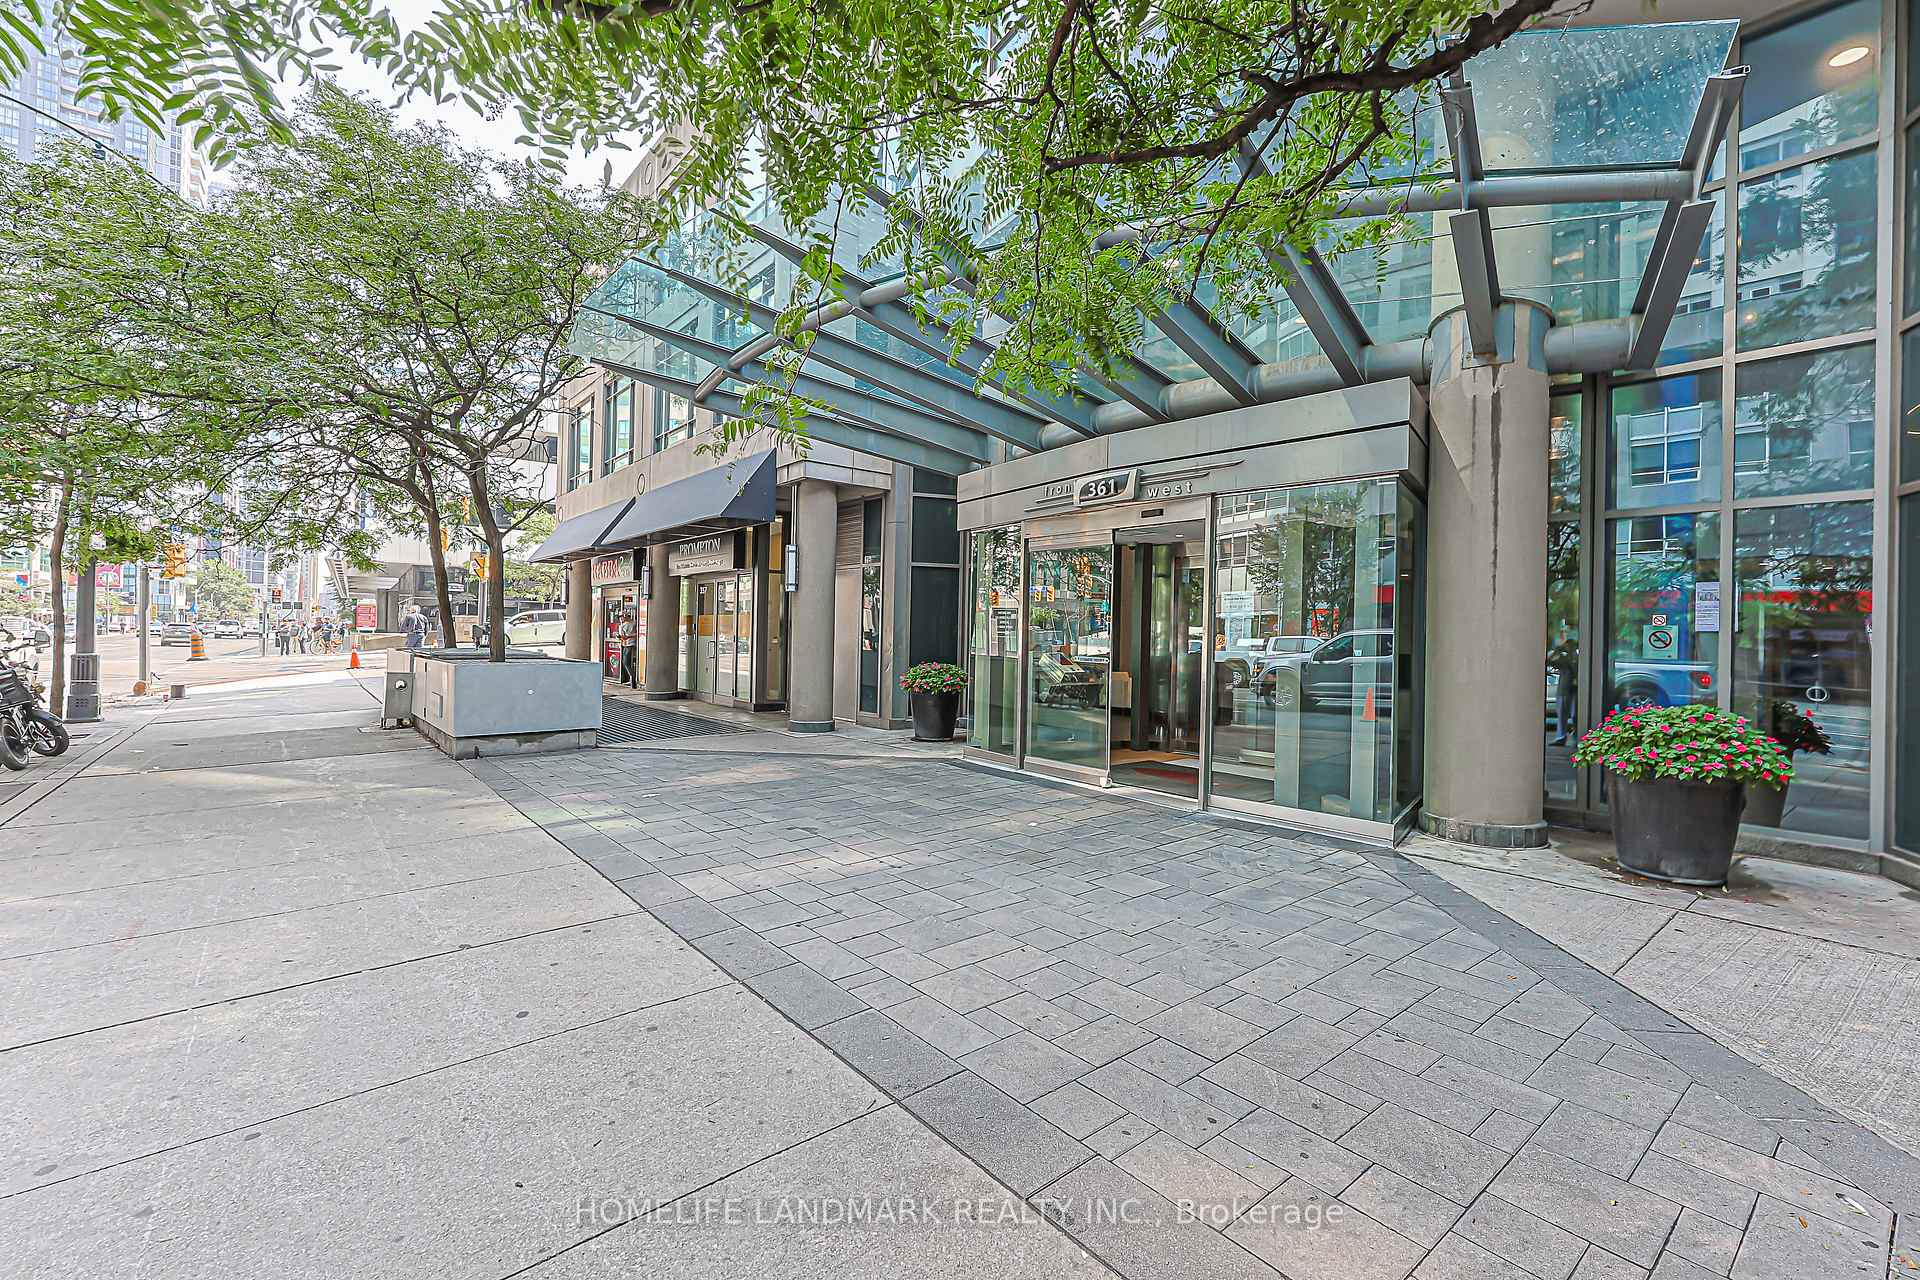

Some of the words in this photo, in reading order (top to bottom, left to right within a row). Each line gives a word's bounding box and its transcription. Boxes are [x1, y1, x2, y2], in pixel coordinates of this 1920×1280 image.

[1088, 478, 1115, 497] 361
[1147, 481, 1192, 498] west
[679, 537, 721, 557] PROMPTON
